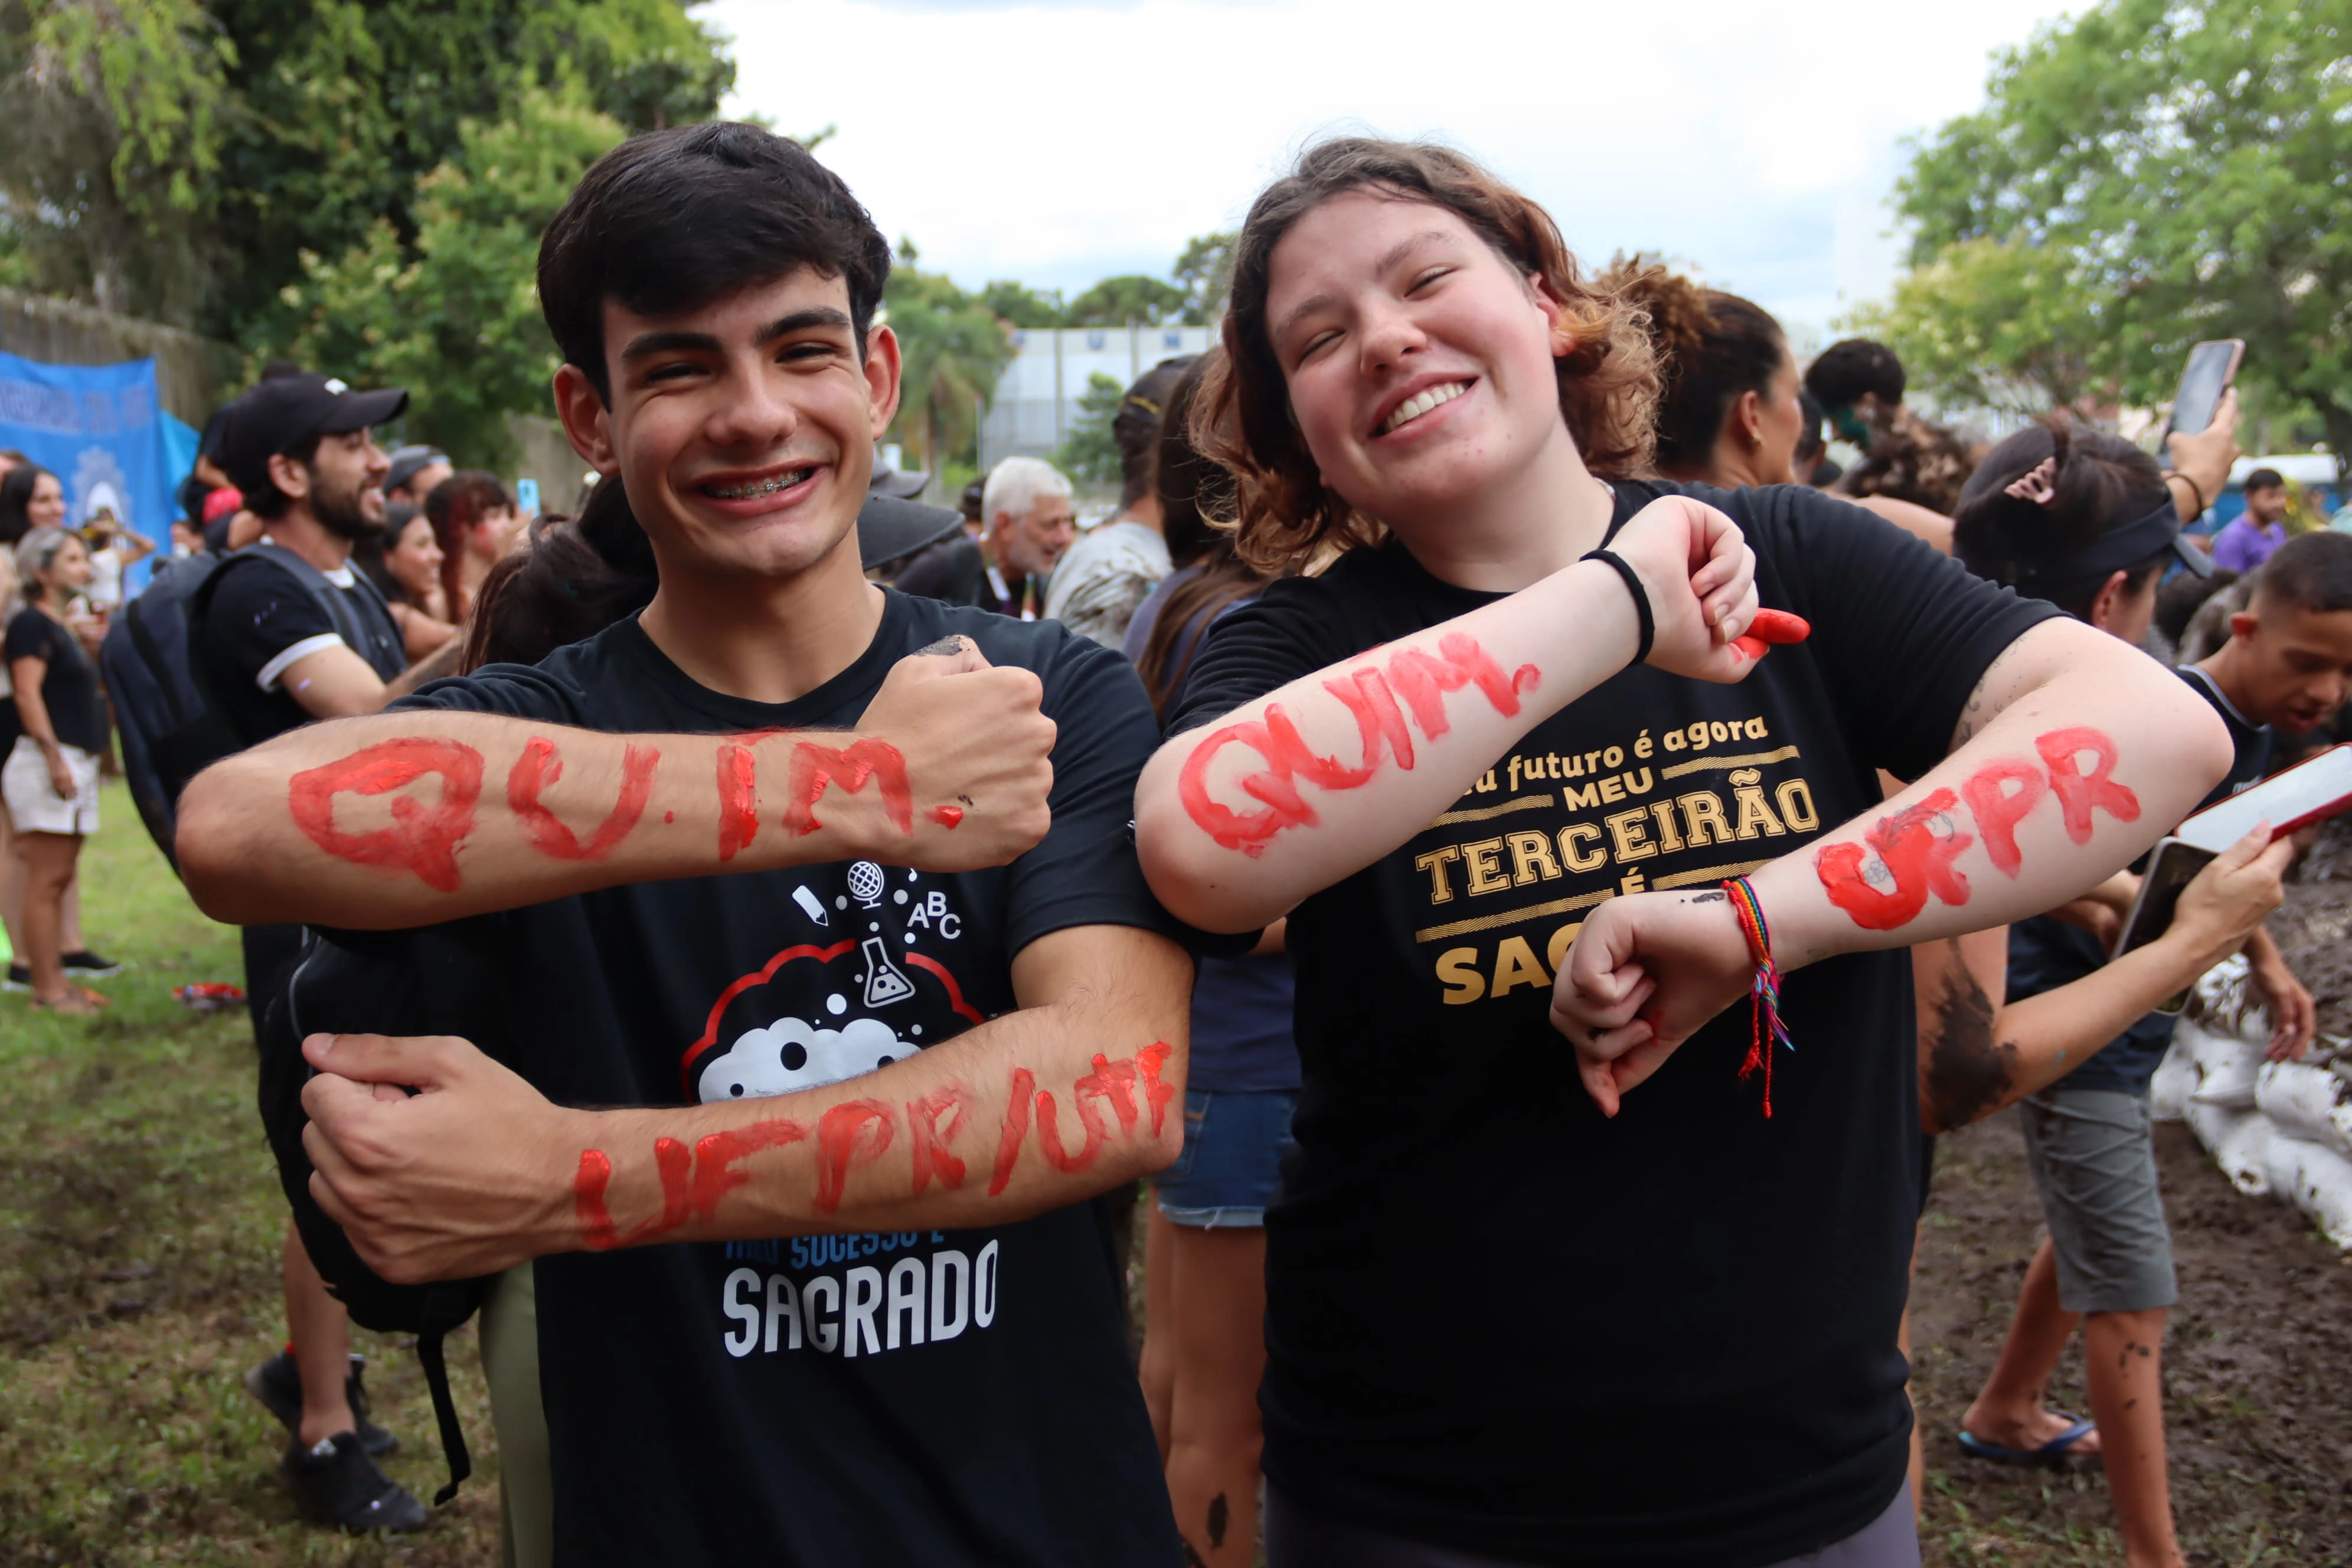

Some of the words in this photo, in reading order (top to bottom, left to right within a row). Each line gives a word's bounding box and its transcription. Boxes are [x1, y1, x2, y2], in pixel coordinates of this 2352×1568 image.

[1507, 746, 1624, 792] futuro
[1634, 729, 1653, 759] é
[1663, 716, 1769, 753] agora
[1563, 766, 1654, 812] MEU
[1415, 767, 1820, 906] TERCEIRÃO
[723, 1239, 998, 1358] SAGRADO
